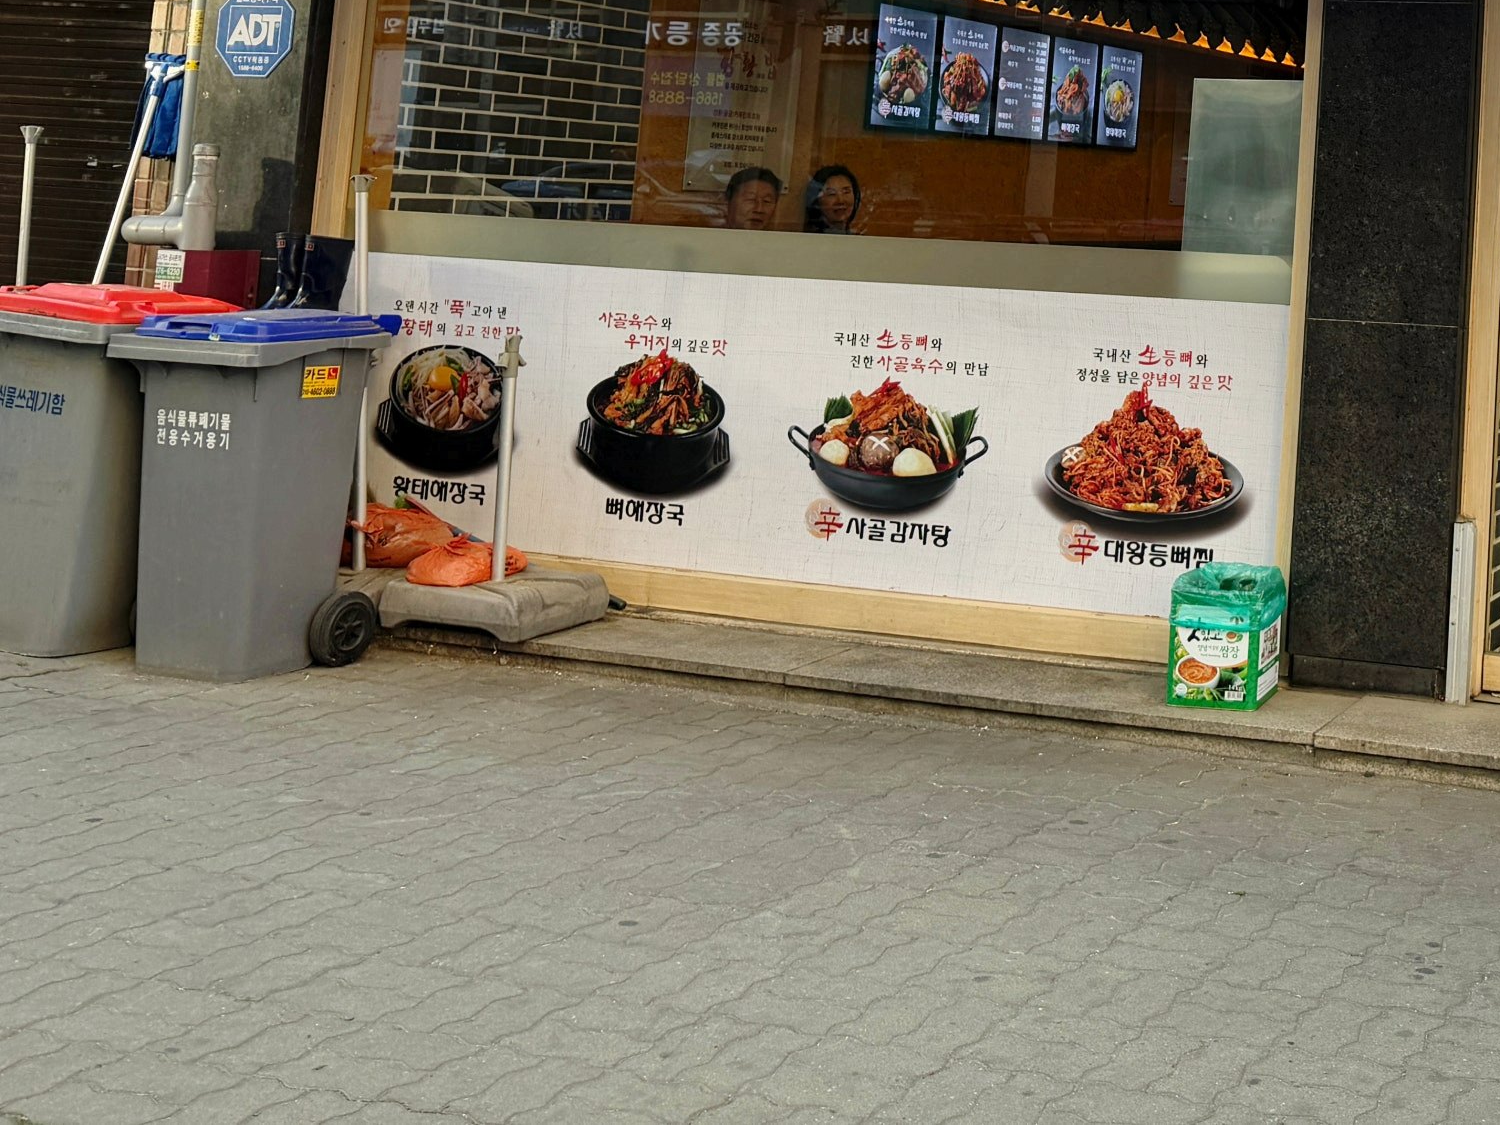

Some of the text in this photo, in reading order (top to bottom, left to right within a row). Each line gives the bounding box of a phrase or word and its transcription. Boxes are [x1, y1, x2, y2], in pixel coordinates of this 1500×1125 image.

[227, 13, 282, 46] ADT
[418, 301, 439, 314] 시간
[497, 306, 507, 319] 낸
[454, 324, 475, 337] 깊고
[481, 326, 502, 340] 진한
[834, 333, 870, 347] 국내산
[850, 355, 874, 369] 진한
[964, 361, 989, 377] 만남
[1093, 347, 1132, 363] 국내산
[305, 368, 326, 381] 카드
[1076, 367, 1112, 383] 정성을
[1117, 370, 1140, 385] 담은
[1188, 374, 1215, 391] 깊은
[1217, 375, 1234, 392] 맛
[156, 408, 231, 431] 음식물류폐기물
[393, 475, 486, 507] 황태해장국
[604, 496, 685, 527] 뼈해장국
[845, 517, 952, 548] 사골감자탕
[1220, 645, 1241, 659] 쌈장
